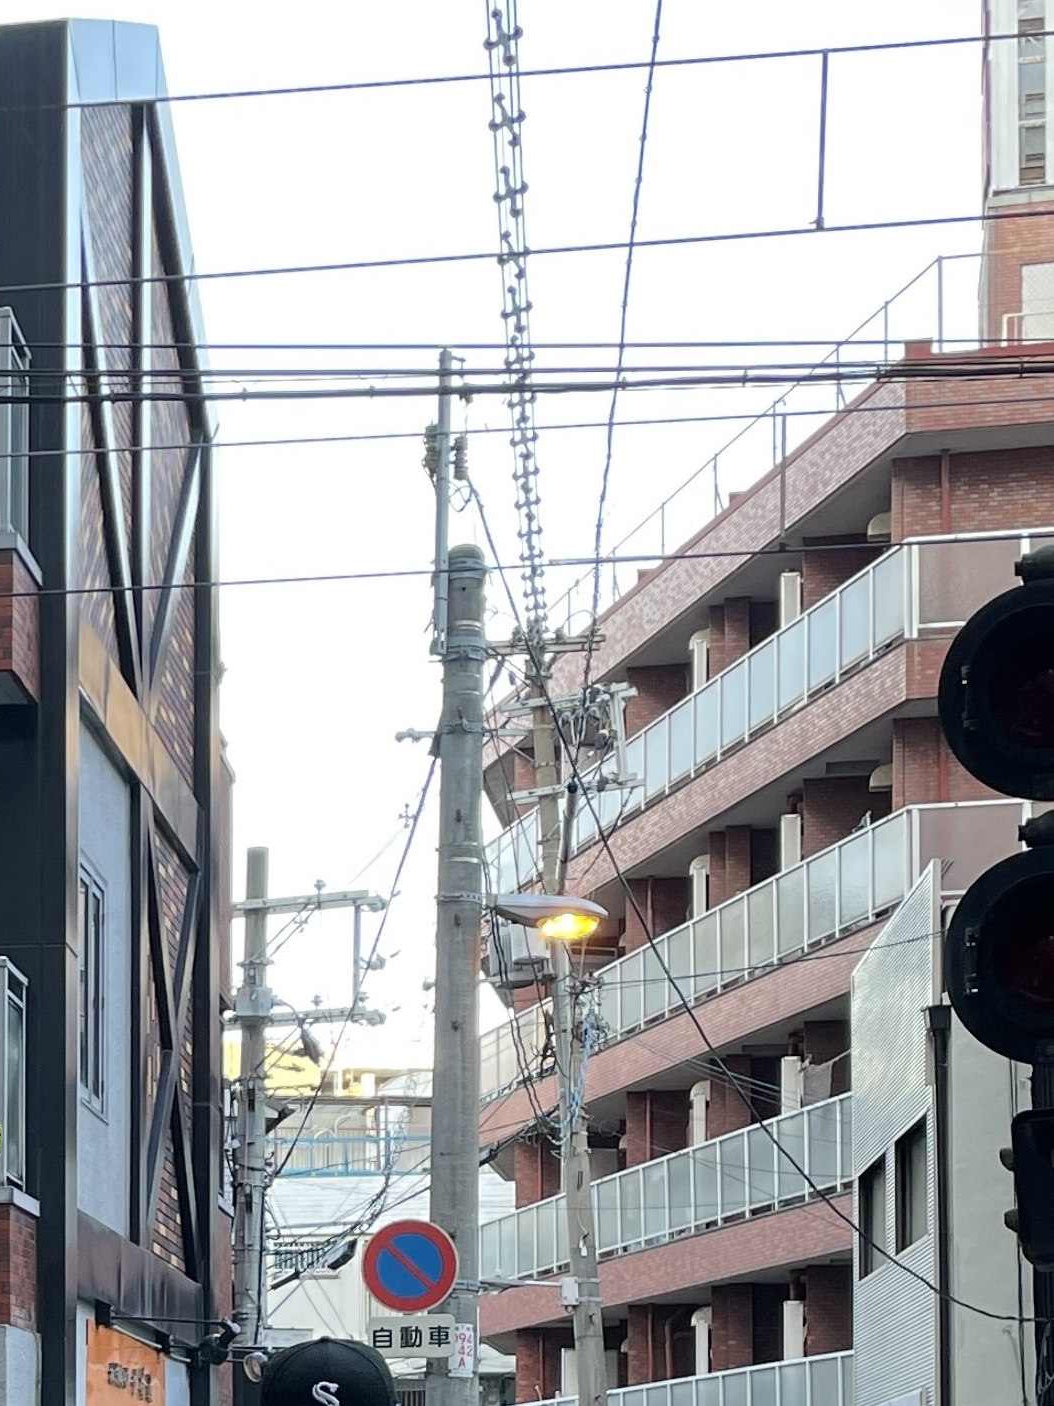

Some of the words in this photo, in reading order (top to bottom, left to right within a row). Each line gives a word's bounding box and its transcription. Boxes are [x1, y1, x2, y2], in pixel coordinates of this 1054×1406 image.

[372, 1325, 451, 1349] 自動車
[455, 1332, 473, 1344] 94
[458, 1357, 466, 1369] A
